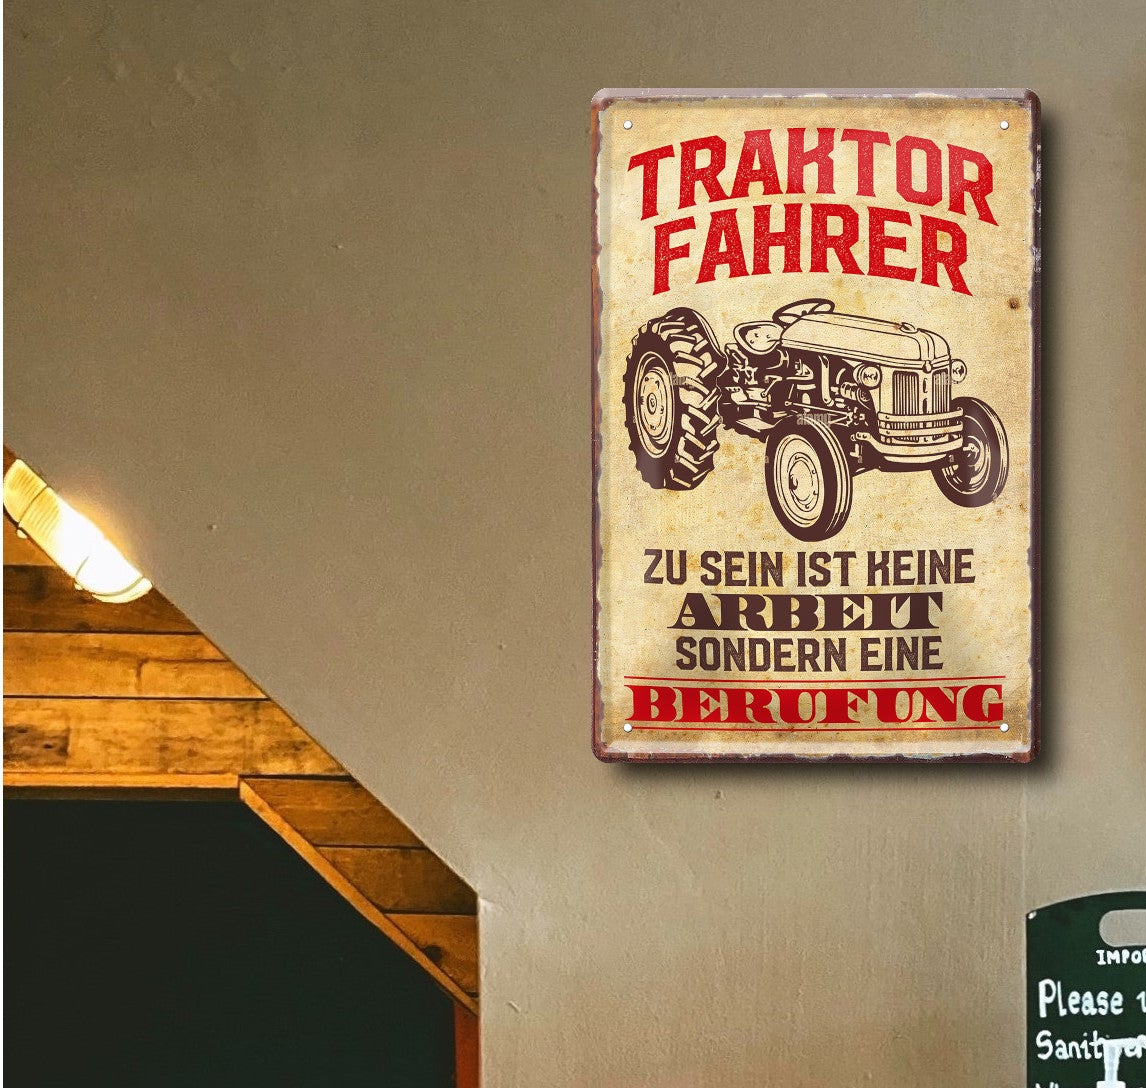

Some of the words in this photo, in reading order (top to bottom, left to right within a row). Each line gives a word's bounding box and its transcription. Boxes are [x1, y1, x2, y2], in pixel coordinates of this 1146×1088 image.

[627, 127, 999, 227] TRAKTOR
[652, 202, 973, 297] FAHRER
[644, 549, 687, 585] ZU
[700, 551, 784, 587] SEIN
[796, 551, 857, 587] IST
[866, 548, 976, 586] KEINE
[666, 591, 943, 632] ARBEIT
[675, 637, 847, 672] SONDERN
[859, 635, 944, 672] EINE
[625, 684, 1004, 724] BERUFUNG
[1038, 978, 1124, 1018] Please
